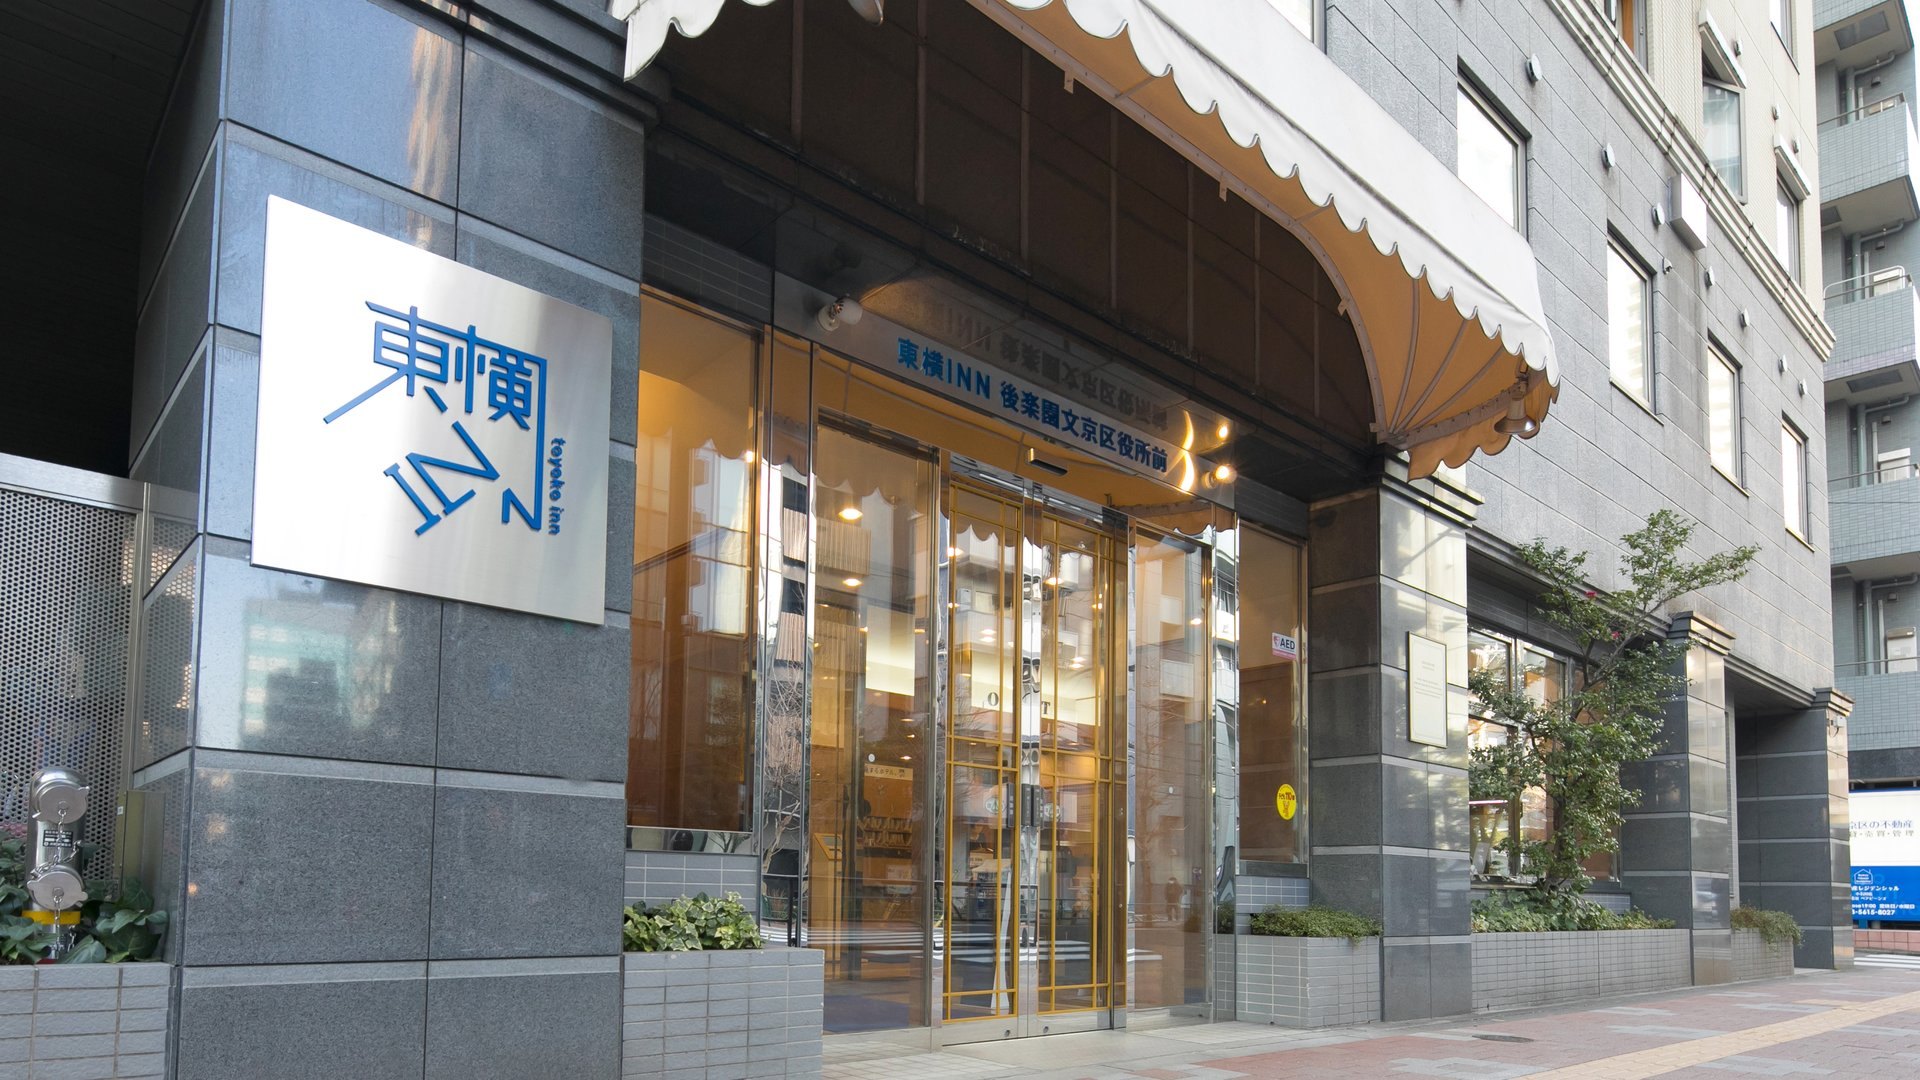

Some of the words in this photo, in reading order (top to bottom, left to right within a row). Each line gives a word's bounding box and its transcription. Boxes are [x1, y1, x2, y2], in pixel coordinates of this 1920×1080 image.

[897, 337, 991, 400] 東横INN
[1000, 380, 1169, 473] 後楽園文京区役所前
[547, 437, 566, 503] toyoko
[548, 505, 565, 536] inn
[1280, 637, 1296, 650] AED
